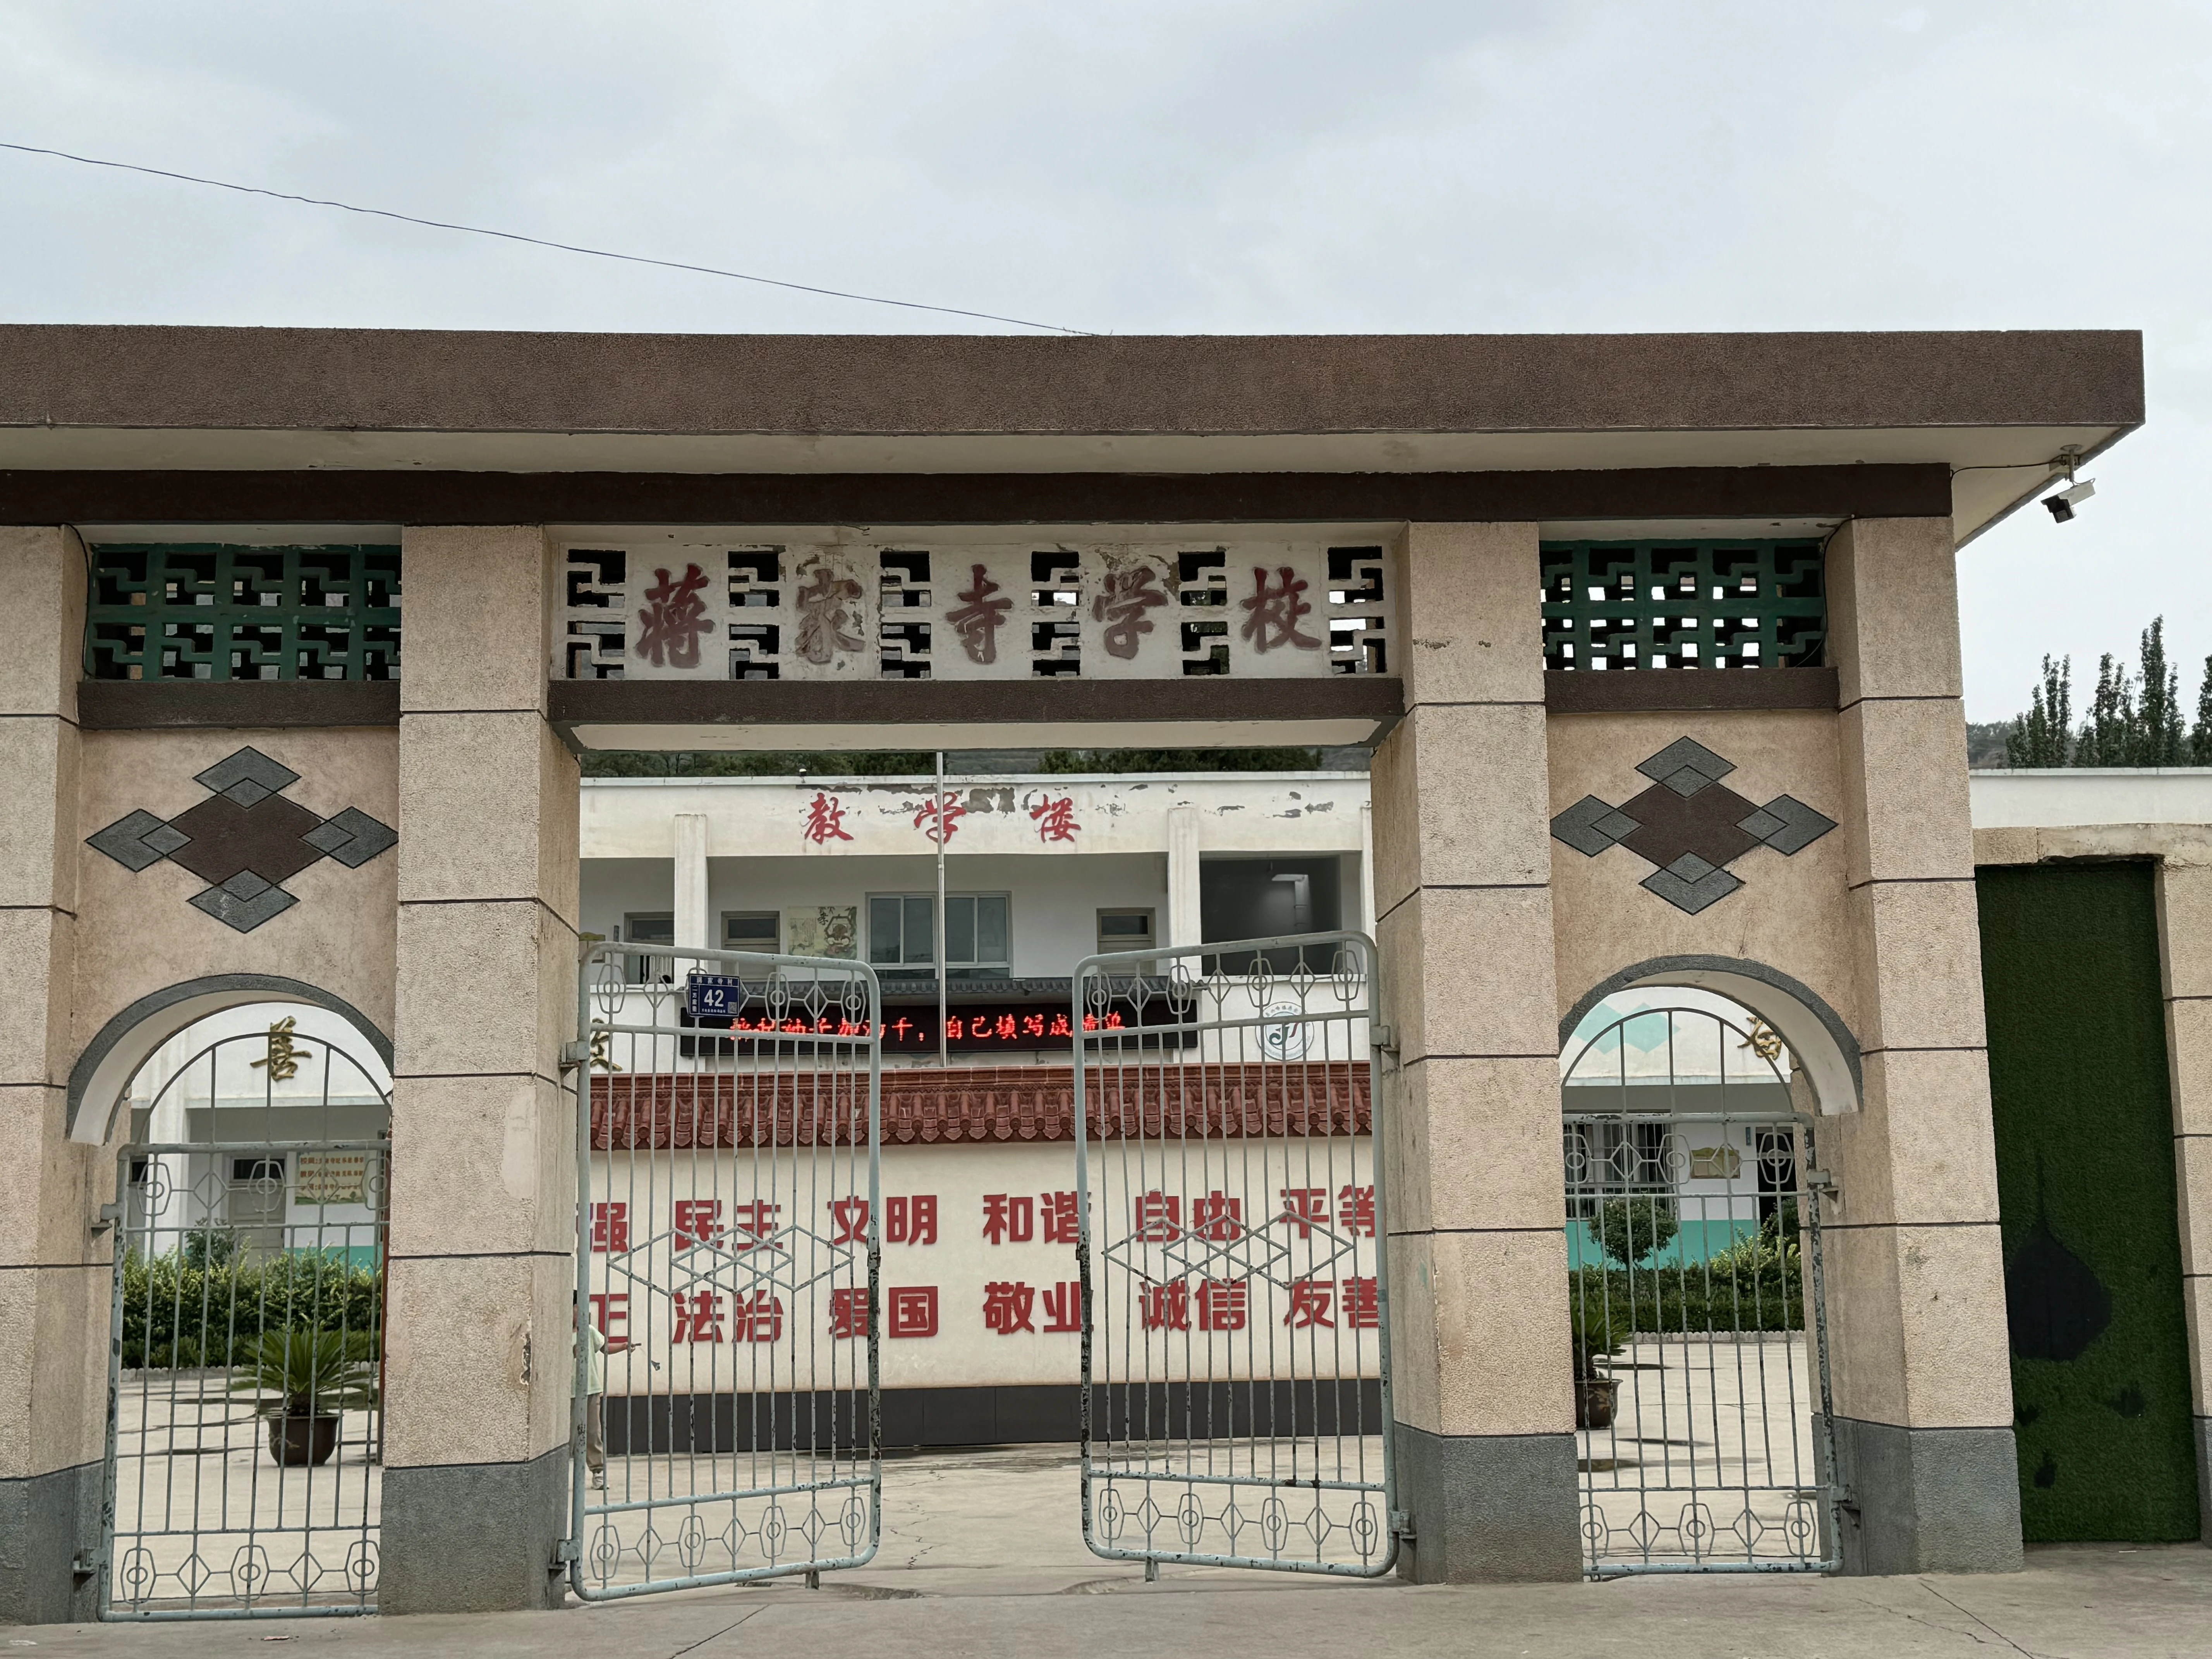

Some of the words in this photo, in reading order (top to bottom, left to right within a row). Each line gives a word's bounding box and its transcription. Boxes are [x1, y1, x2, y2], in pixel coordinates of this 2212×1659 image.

[635, 563, 1322, 669] 蒋家寺学校
[804, 792, 1082, 844] 教学楼
[704, 989, 724, 1007] 42
[675, 1200, 783, 1251] 民主
[827, 1195, 937, 1245] 文明
[983, 1191, 1091, 1245] 和谐
[1135, 1190, 1241, 1242] 自由
[1280, 1185, 1375, 1238] 平等
[672, 1290, 783, 1343] 法治
[829, 1286, 938, 1339] 爱国
[983, 1281, 1093, 1334] 敬业
[1139, 1278, 1246, 1331] 诚信
[1283, 1276, 1378, 1328] 友善
